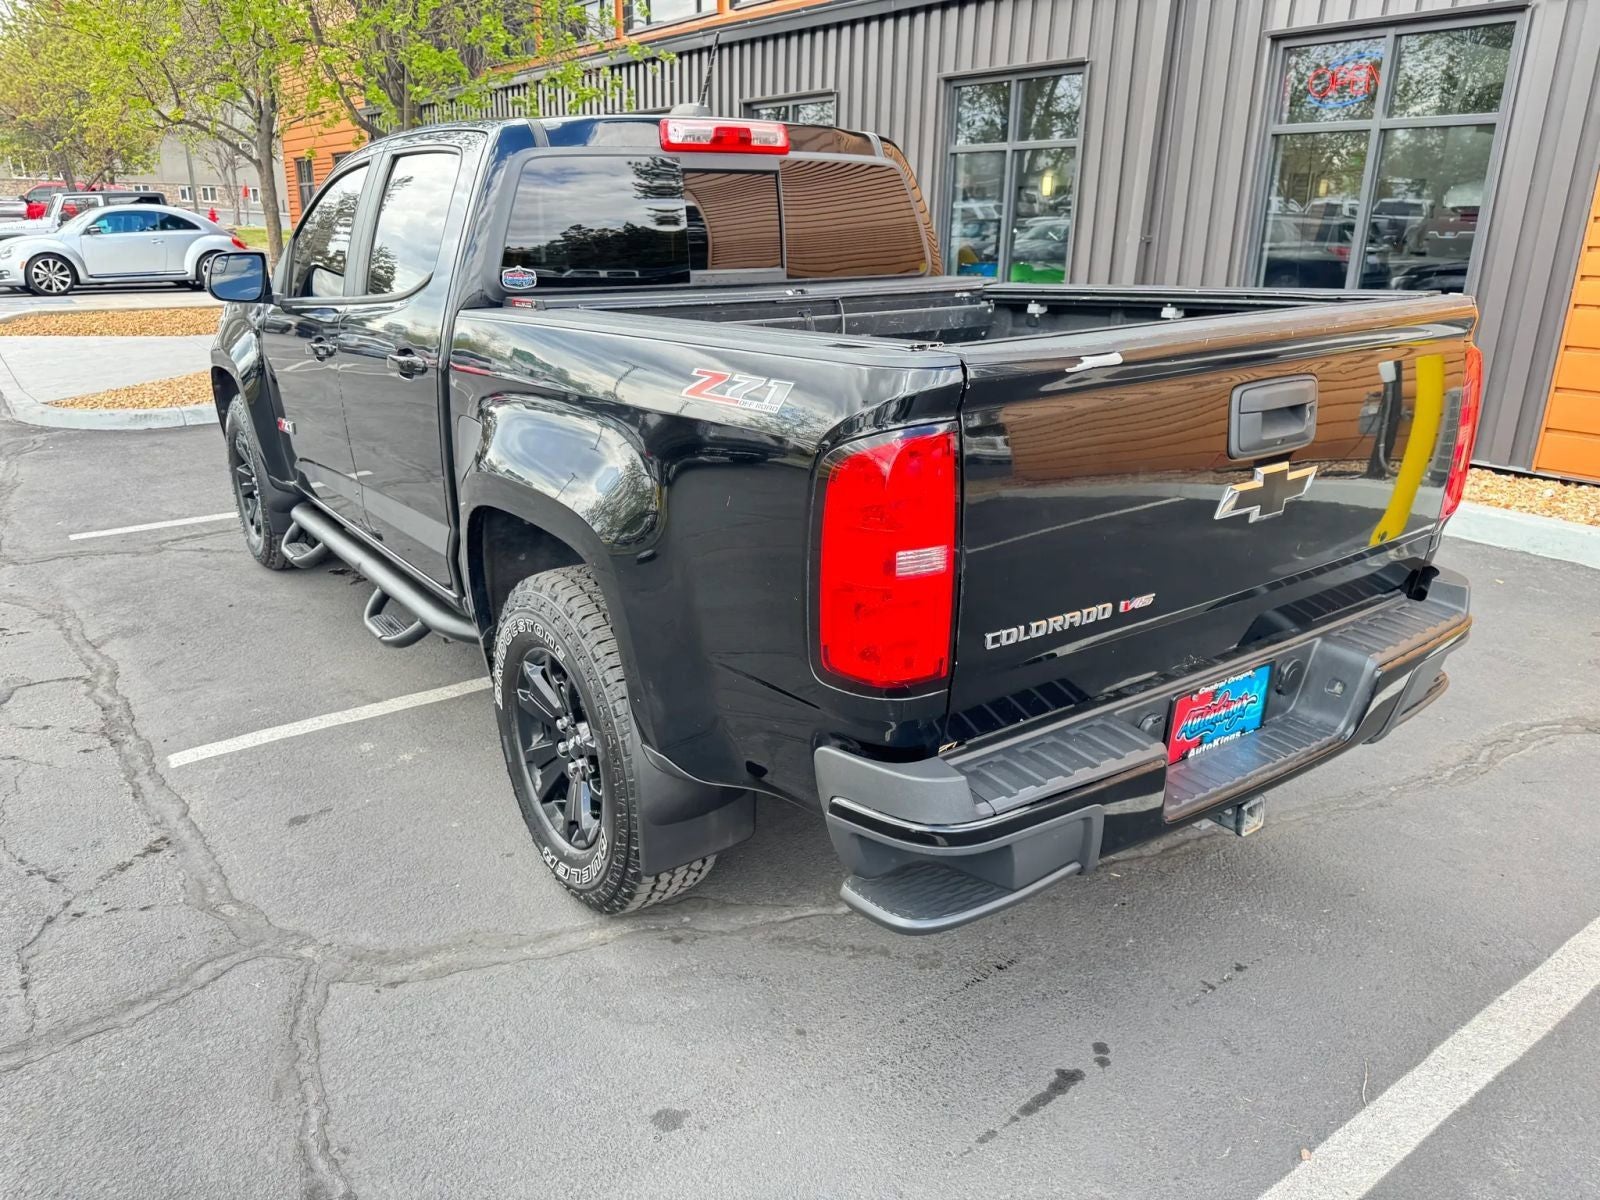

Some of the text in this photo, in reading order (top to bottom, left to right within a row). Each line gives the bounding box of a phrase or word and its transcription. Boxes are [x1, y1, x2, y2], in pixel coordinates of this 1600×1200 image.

[1308, 64, 1380, 99] OPEN
[682, 368, 795, 408] Z71
[984, 602, 1113, 650] COLORADO
[494, 618, 566, 710] BRIDGESTONE
[1199, 679, 1228, 695] Central
[542, 827, 608, 884] DUELER
